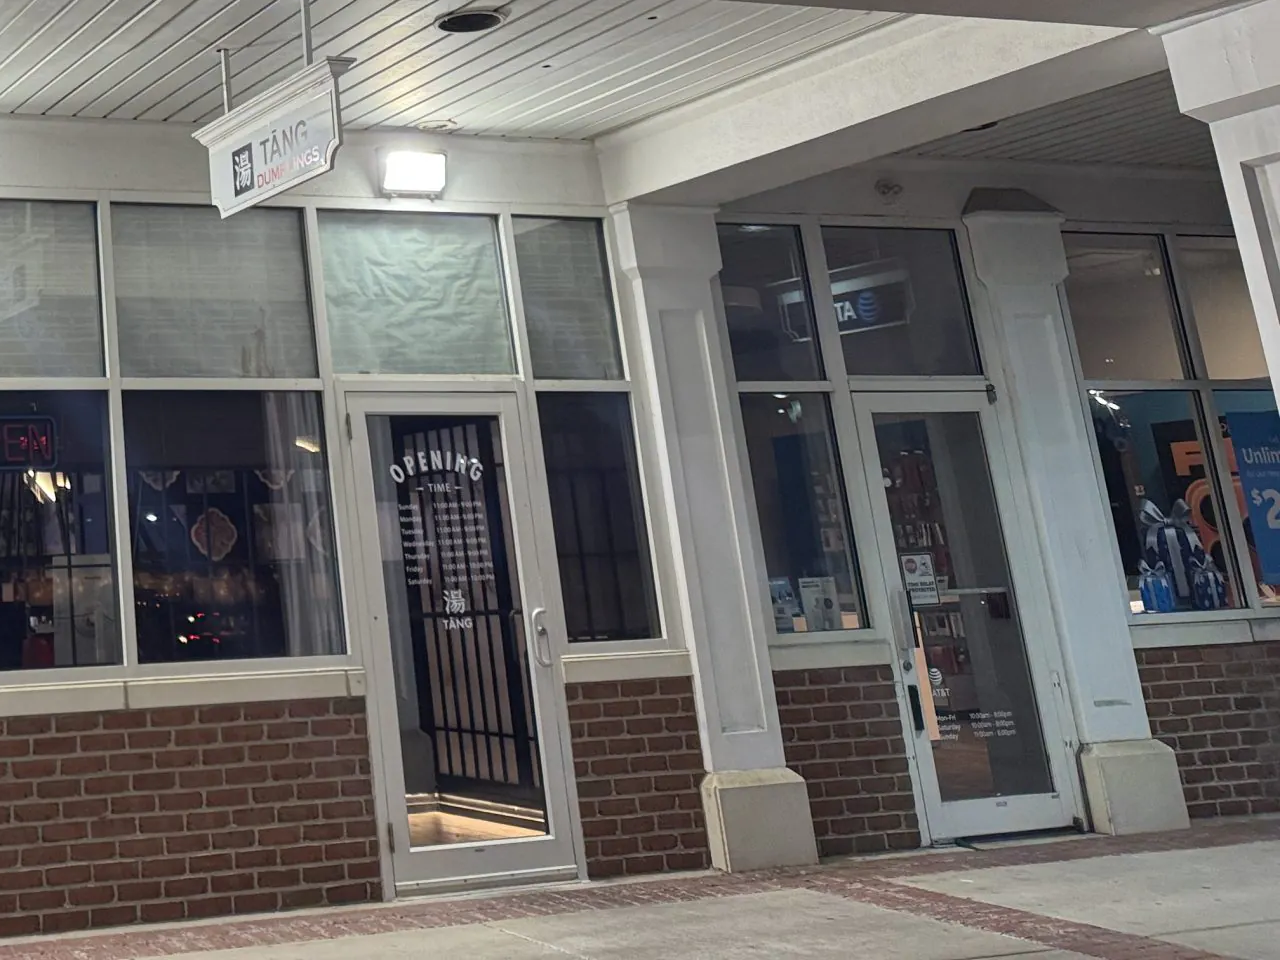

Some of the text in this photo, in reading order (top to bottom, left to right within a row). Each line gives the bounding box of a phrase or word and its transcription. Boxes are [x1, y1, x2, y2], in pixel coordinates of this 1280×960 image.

[234, 149, 252, 191] 湯
[257, 145, 320, 189] DUMPINGS
[389, 450, 483, 483] OPENING
[427, 483, 451, 492] TIME
[443, 588, 466, 614] 湯
